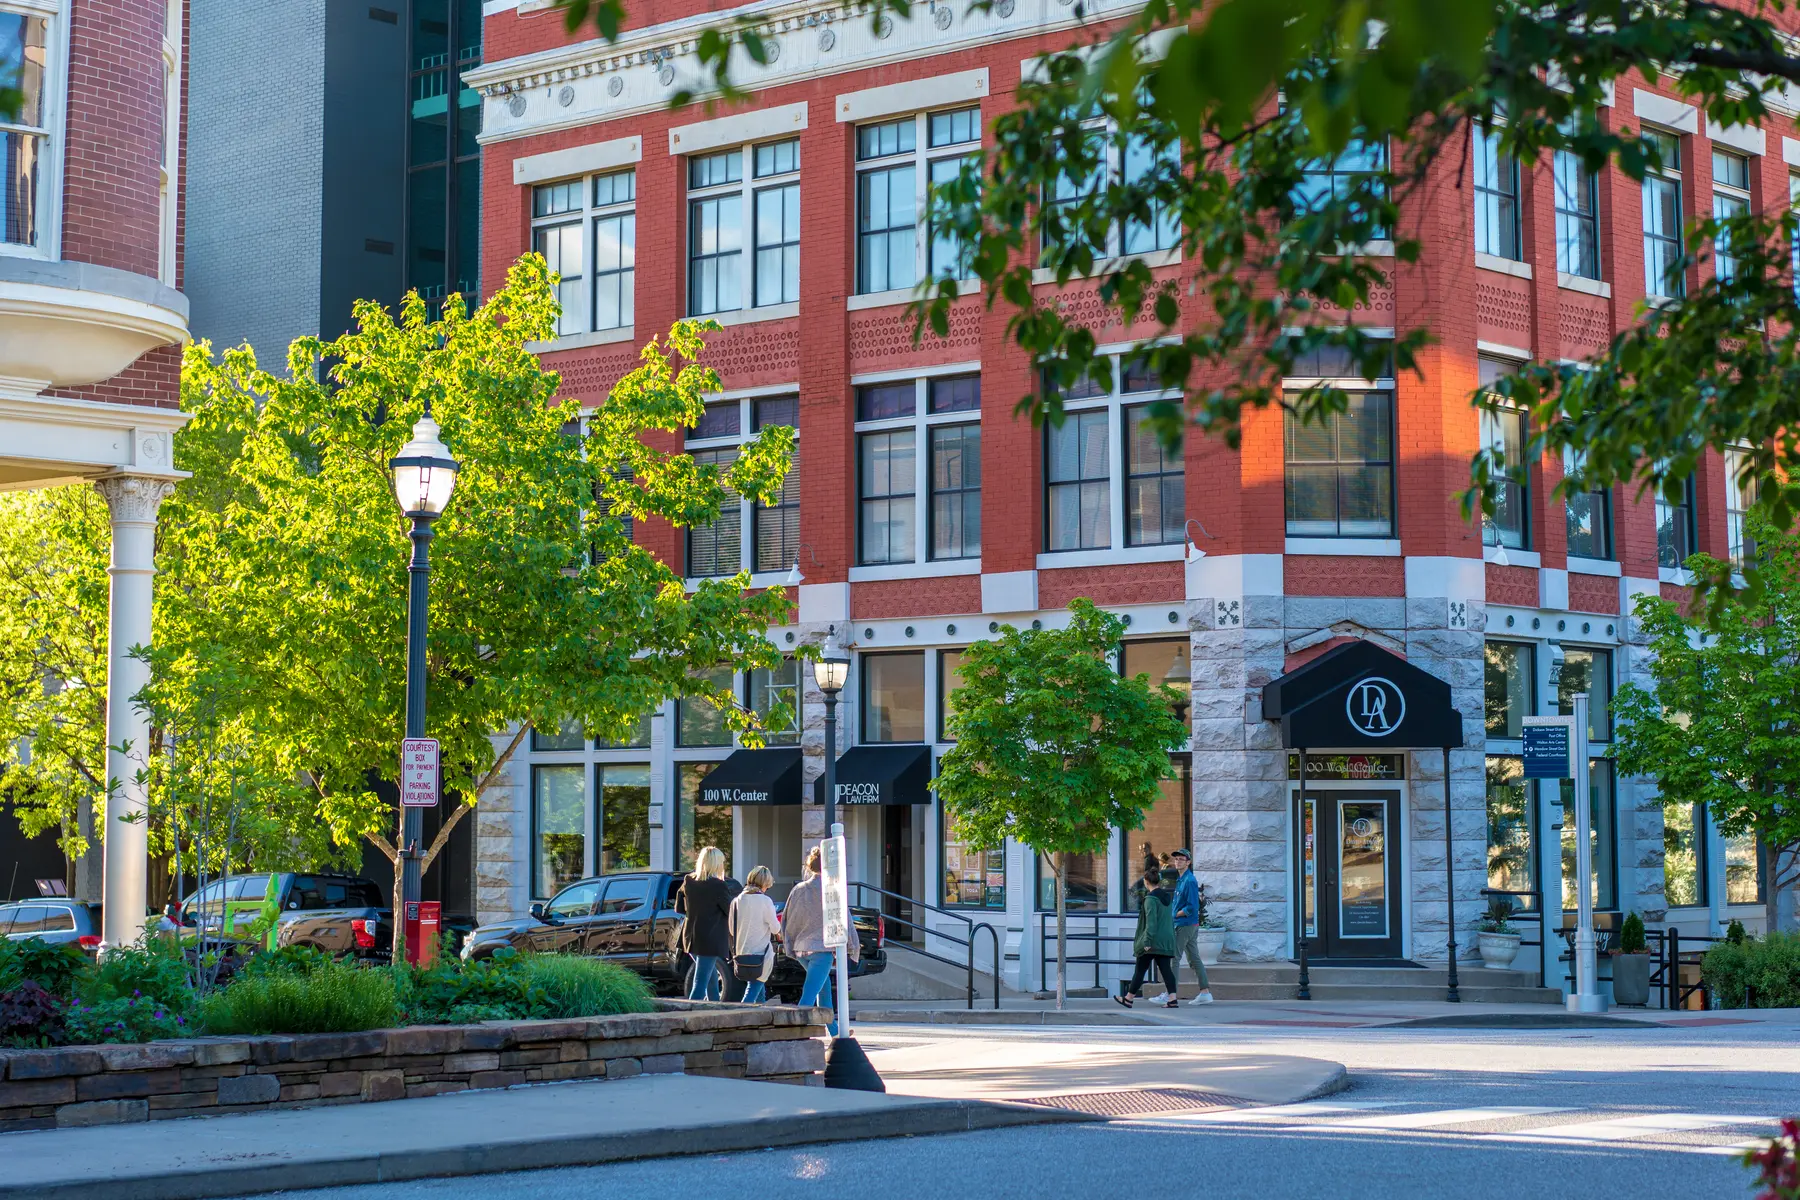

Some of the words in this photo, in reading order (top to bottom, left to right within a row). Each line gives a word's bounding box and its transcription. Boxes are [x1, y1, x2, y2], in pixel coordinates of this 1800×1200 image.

[406, 744, 435, 752] COURTESY
[409, 782, 431, 790] PARKING
[840, 783, 879, 795] DEACON
[405, 792, 435, 800] VIOLATIONS
[704, 789, 720, 801] 100
[721, 788, 732, 801] W.
[733, 788, 768, 801] Center
[846, 796, 862, 804] LAW
[862, 795, 879, 803] FIRM
